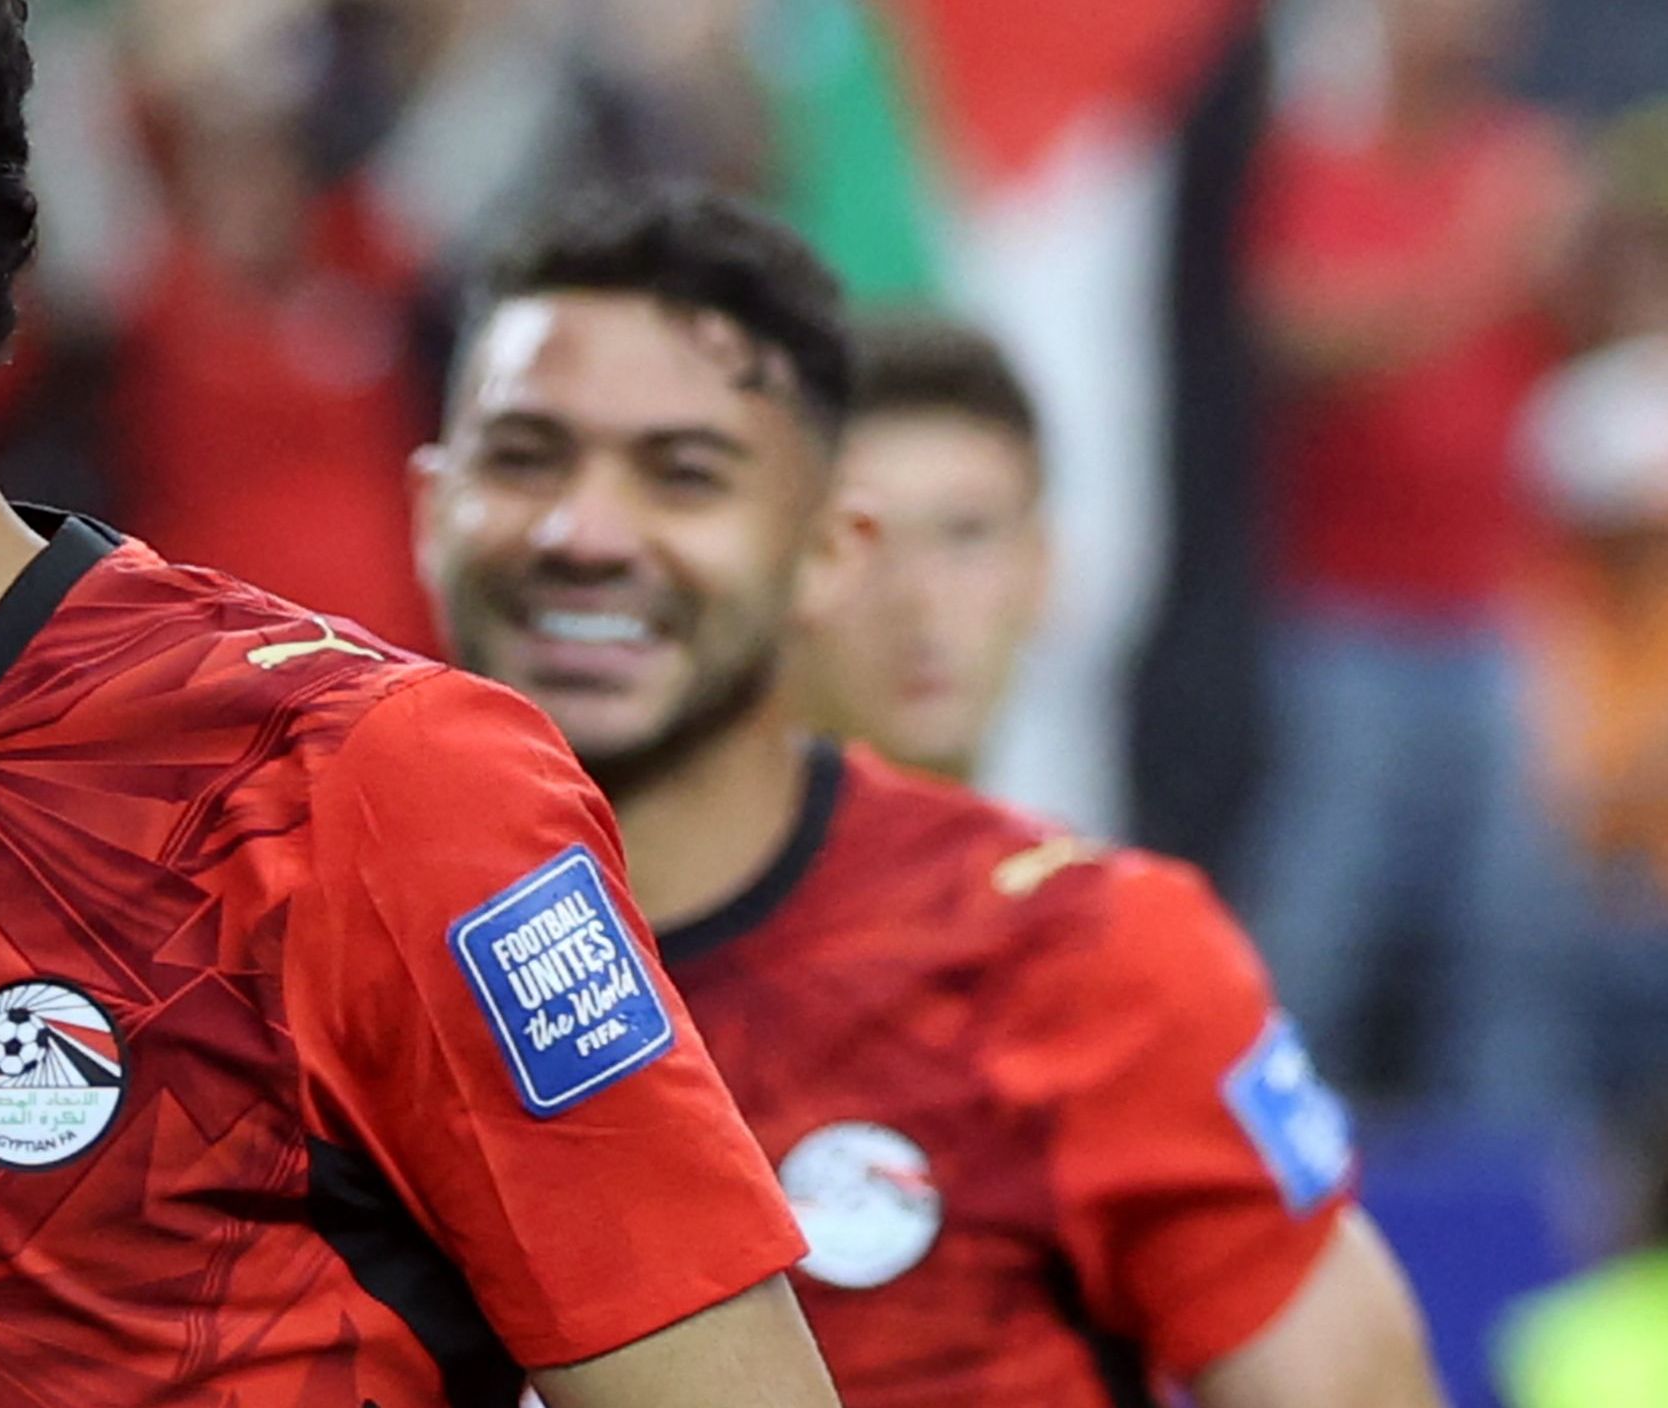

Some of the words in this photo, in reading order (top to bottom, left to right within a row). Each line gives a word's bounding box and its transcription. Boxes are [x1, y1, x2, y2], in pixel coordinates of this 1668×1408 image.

[491, 890, 597, 971] FOOTBALL
[508, 920, 616, 1010] UNITES
[523, 1010, 573, 1051] the
[569, 958, 641, 1026] World
[576, 1018, 626, 1057] FIFA
[58, 1130, 77, 1146] FA
